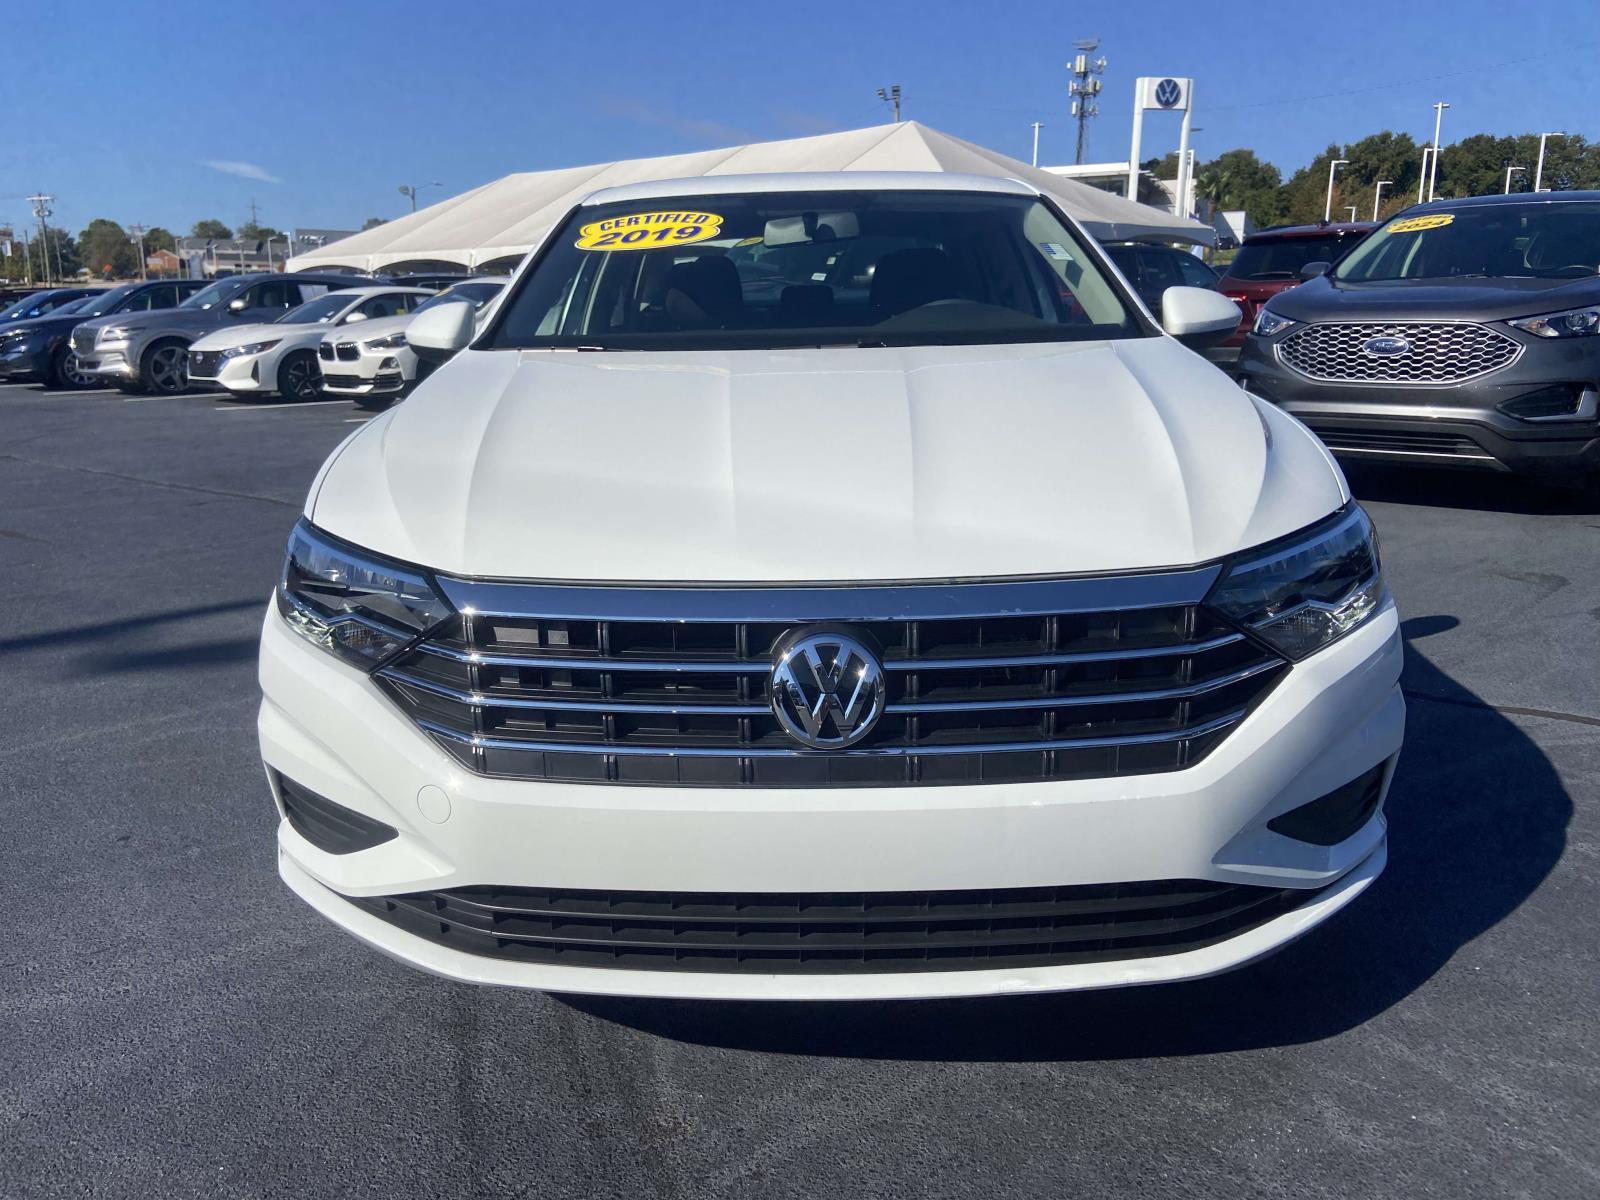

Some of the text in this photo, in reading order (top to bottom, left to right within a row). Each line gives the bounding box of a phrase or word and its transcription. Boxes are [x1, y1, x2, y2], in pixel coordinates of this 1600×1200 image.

[1156, 79, 1181, 105] VW
[600, 213, 710, 232] CERTIFIED
[590, 225, 703, 248] 2019
[778, 636, 879, 746] VW
